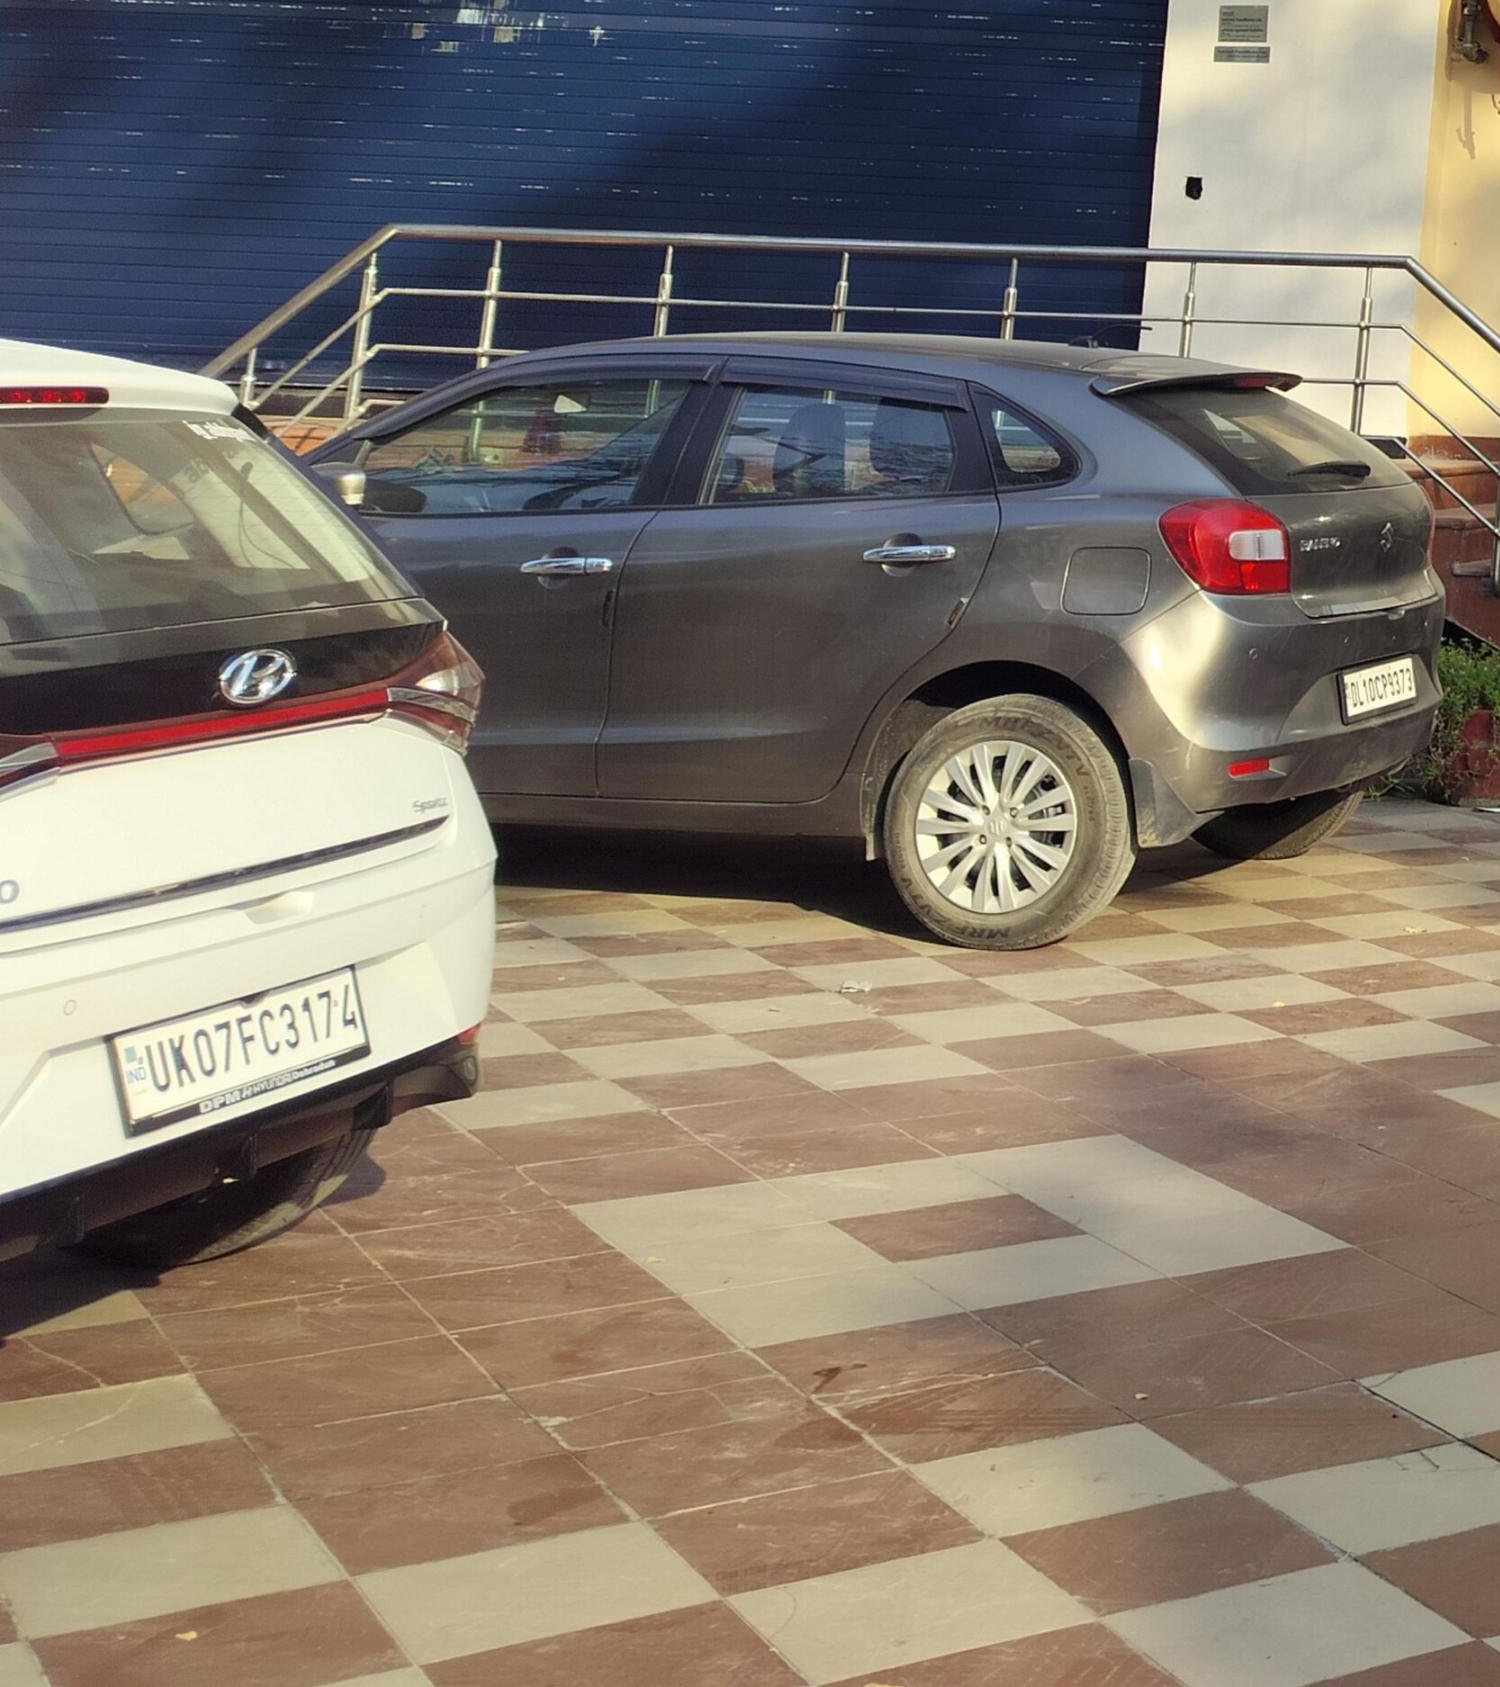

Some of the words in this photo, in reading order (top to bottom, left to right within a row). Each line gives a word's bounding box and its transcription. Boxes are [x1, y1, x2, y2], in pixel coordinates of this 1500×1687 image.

[1350, 667, 1413, 708] DL10CP9373
[145, 984, 359, 1093] UK07FC3174
[199, 1090, 241, 1113] DPM
